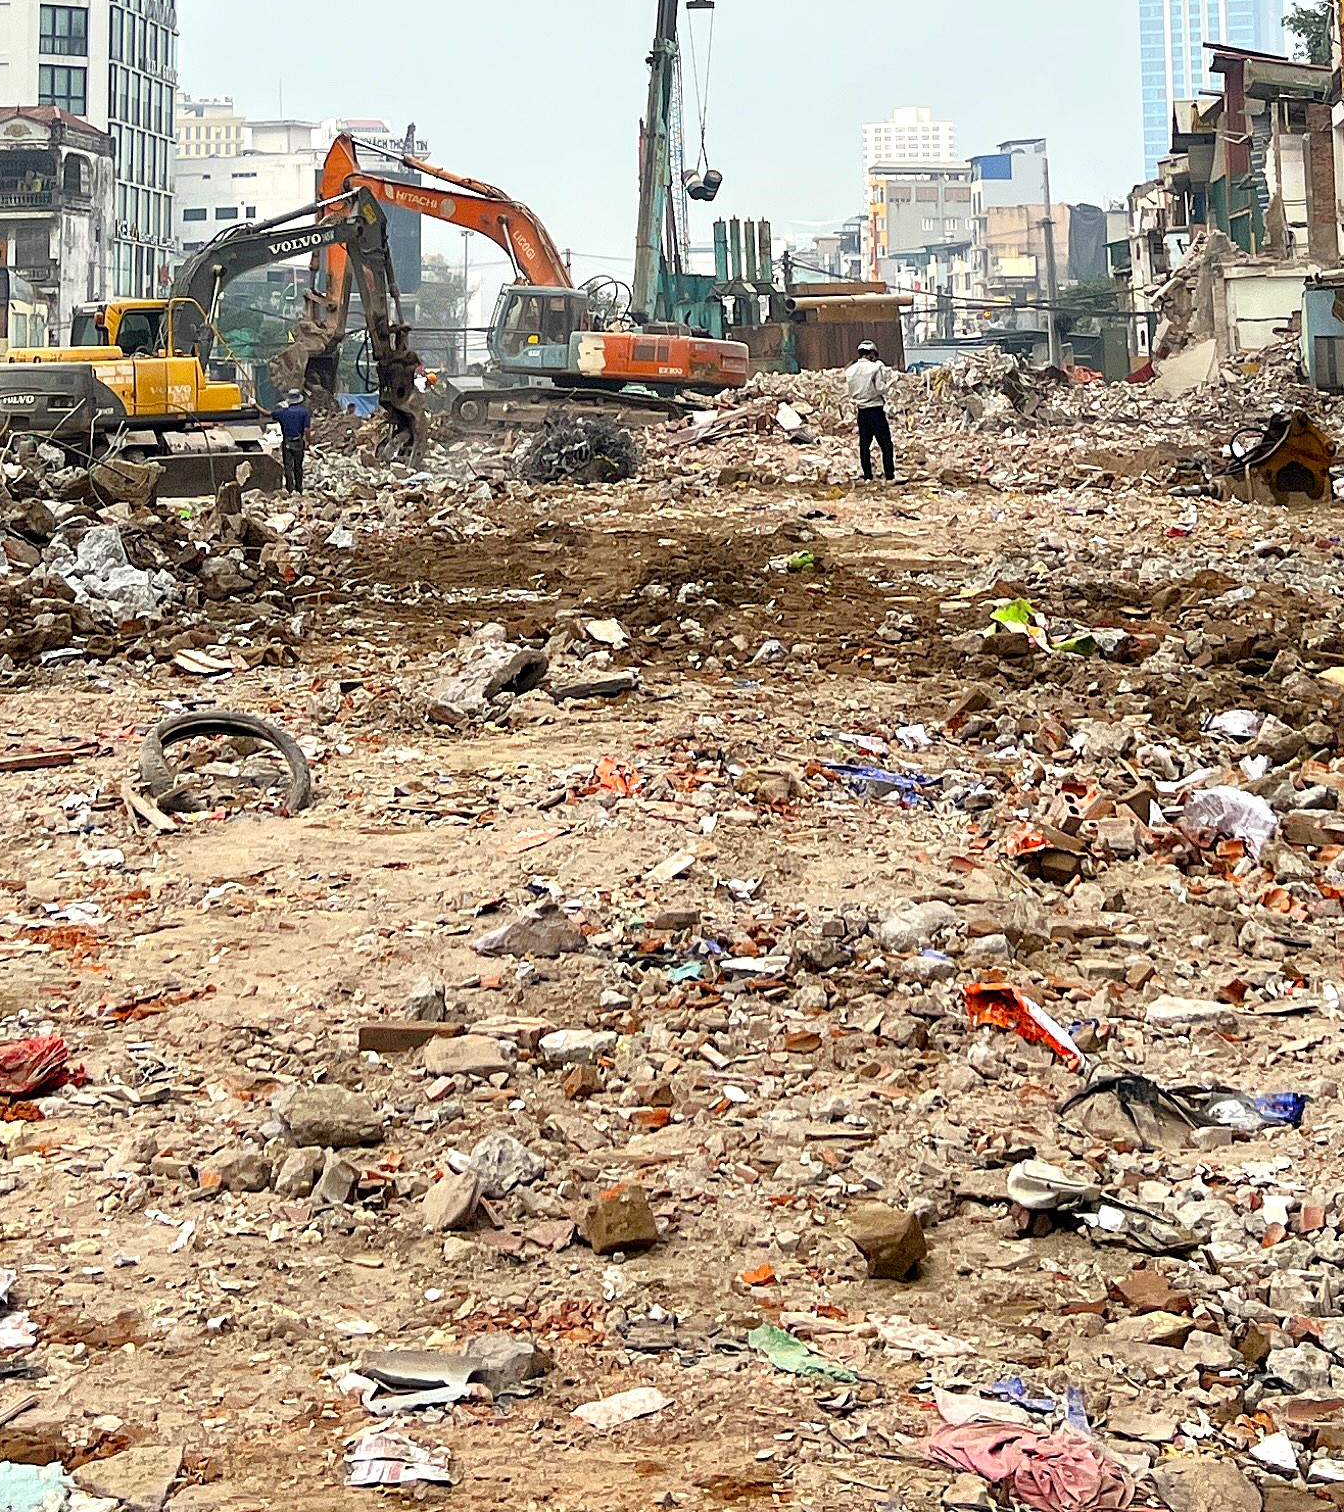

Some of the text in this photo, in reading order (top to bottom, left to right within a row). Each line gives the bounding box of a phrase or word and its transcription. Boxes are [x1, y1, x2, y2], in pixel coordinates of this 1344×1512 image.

[416, 139, 428, 151] TIN
[396, 190, 438, 208] HITACHI
[268, 233, 322, 254] VOLVO
[513, 230, 536, 260] LICOGI
